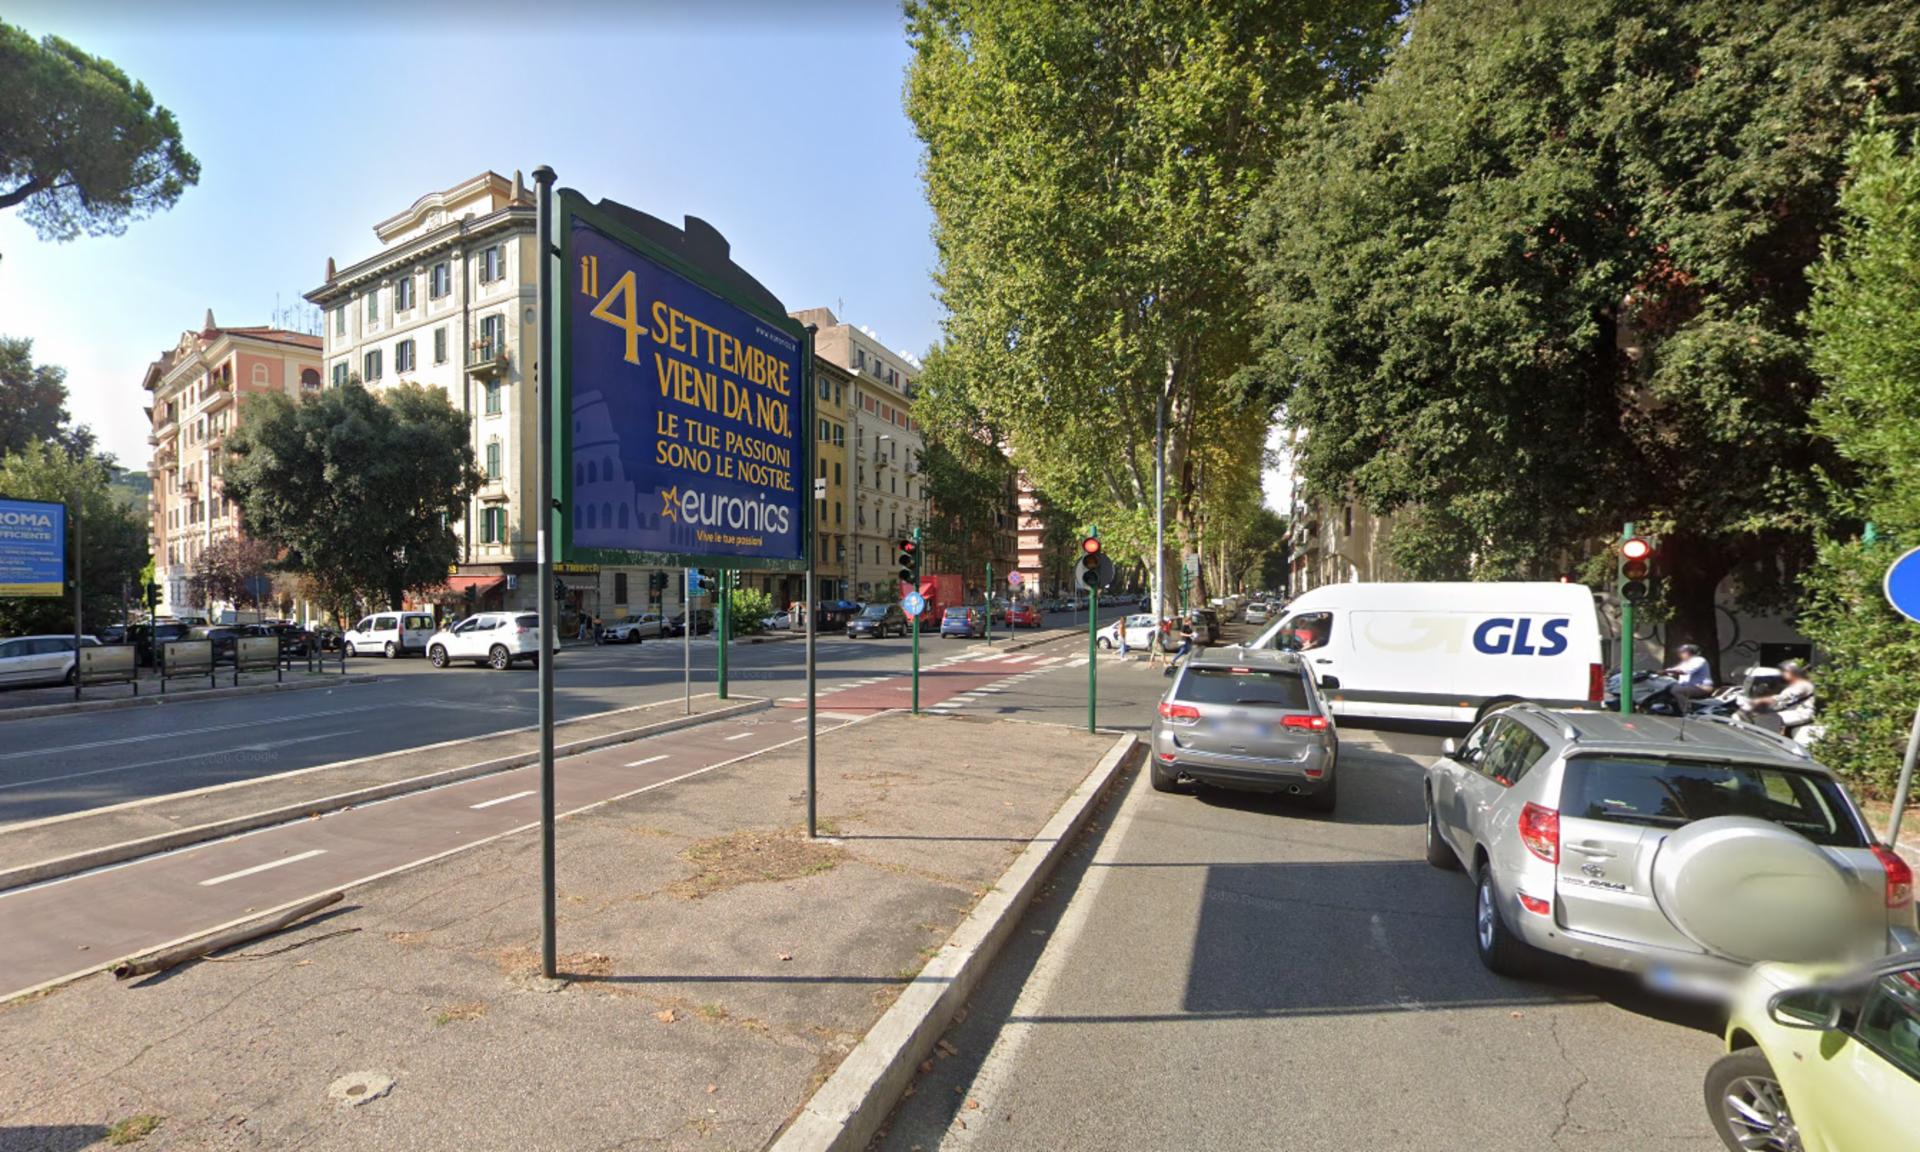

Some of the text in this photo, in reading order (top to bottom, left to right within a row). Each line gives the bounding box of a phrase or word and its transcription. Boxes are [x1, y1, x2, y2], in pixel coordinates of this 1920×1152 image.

[581, 255, 598, 299] il
[590, 270, 648, 365] 4
[651, 301, 791, 397] SETTEMBRE
[654, 352, 793, 439] VIENI DA NOI.
[657, 411, 791, 468] LE TUE PASSIONI
[656, 440, 795, 492] SONO LE NOSTRE.
[681, 490, 789, 534] euronics
[696, 530, 713, 542] Vive
[736, 536, 763, 547] passioni
[1472, 617, 1570, 656] GLS
